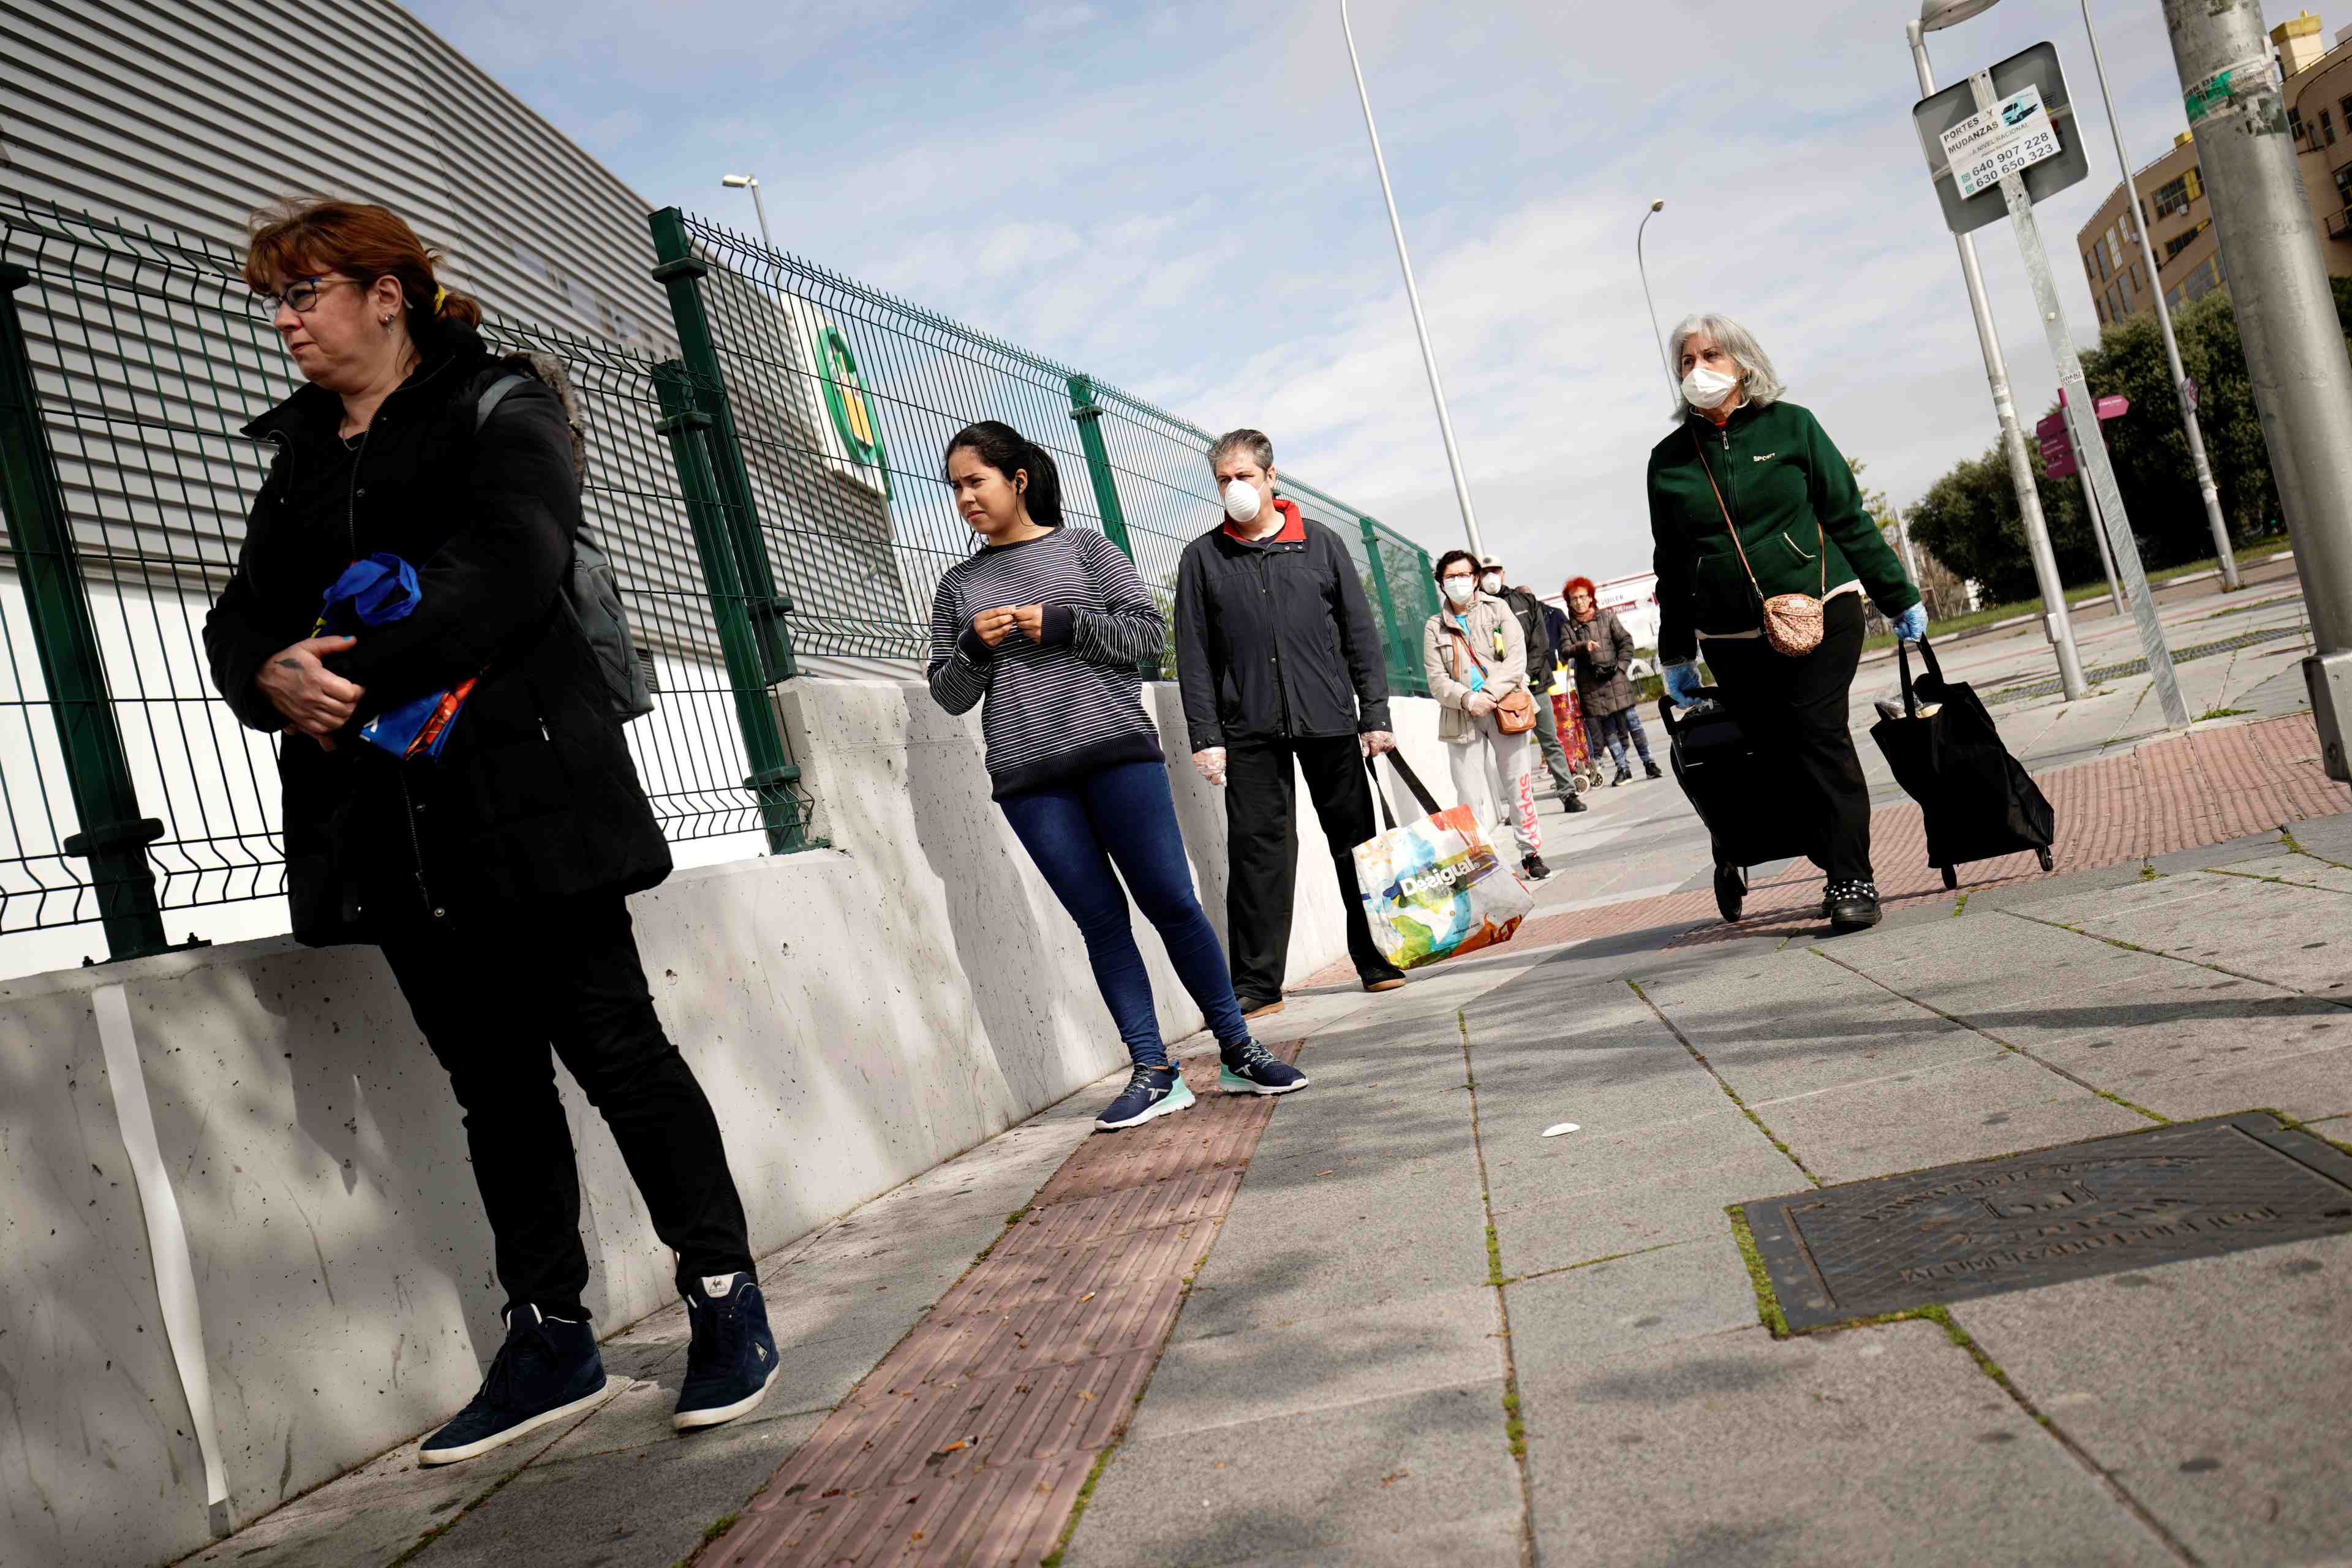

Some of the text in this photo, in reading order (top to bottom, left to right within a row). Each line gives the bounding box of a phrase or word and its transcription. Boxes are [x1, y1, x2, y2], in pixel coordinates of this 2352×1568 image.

[1943, 109, 1993, 143] PORTES Y
[1948, 121, 1999, 154] MUDANZAS
[1972, 159, 1994, 176] 640
[1997, 146, 2020, 163] 907
[2024, 132, 2049, 150] 228
[1976, 170, 1998, 187] 630
[2001, 156, 2026, 175] 650
[2029, 143, 2054, 161] 323
